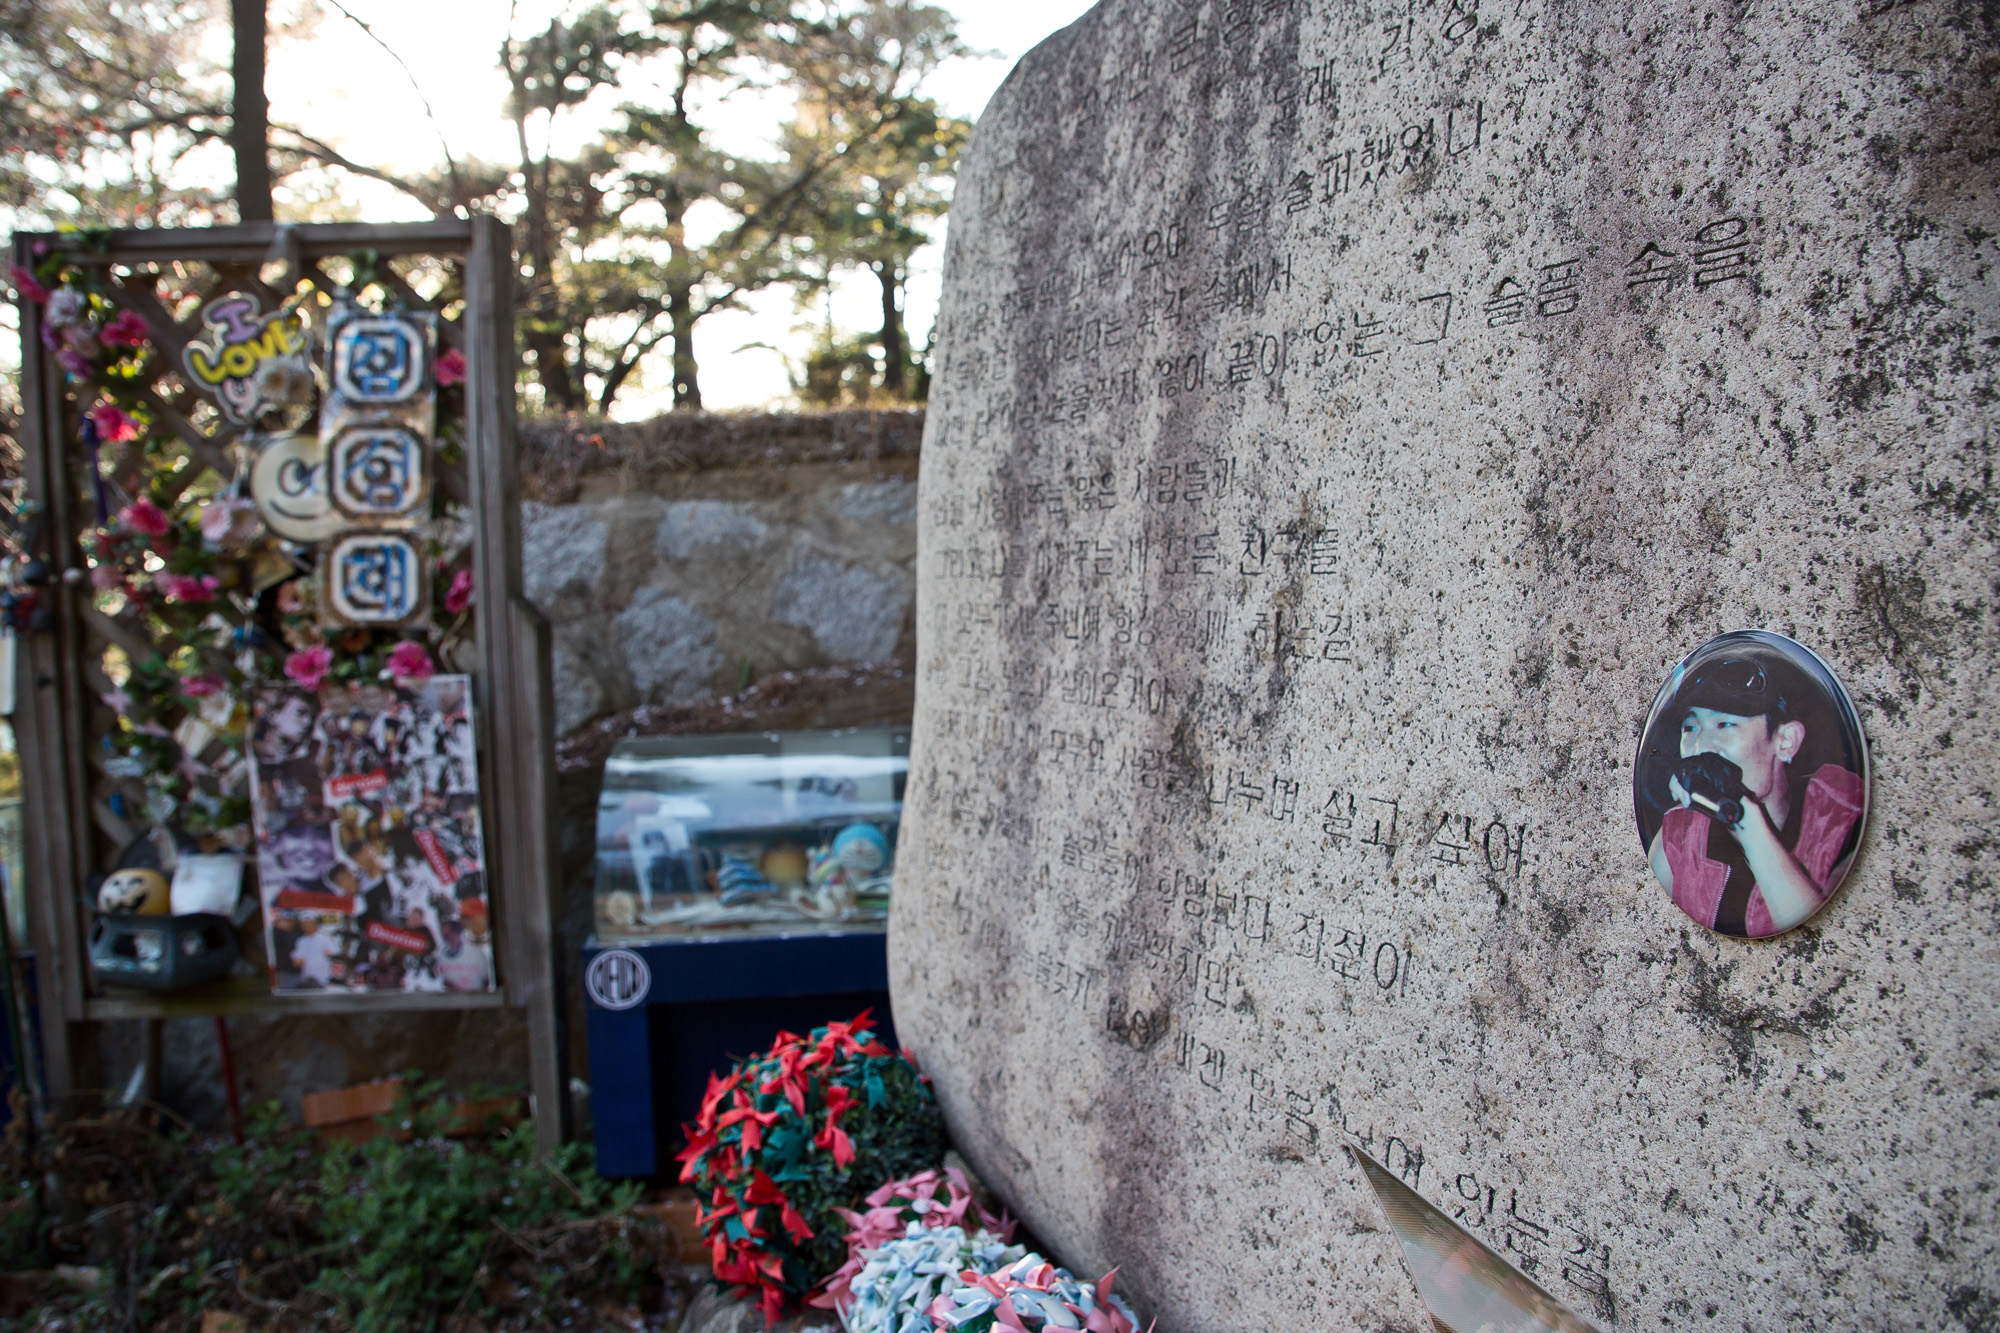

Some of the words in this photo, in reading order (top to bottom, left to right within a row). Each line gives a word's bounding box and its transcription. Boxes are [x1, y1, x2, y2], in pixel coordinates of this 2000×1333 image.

[1314, 312, 1384, 366] 없는
[1412, 291, 1453, 346] 그
[1482, 258, 1580, 329] 슬픔
[1626, 217, 1753, 290] 속을
[1430, 808, 1527, 881] 싶어
